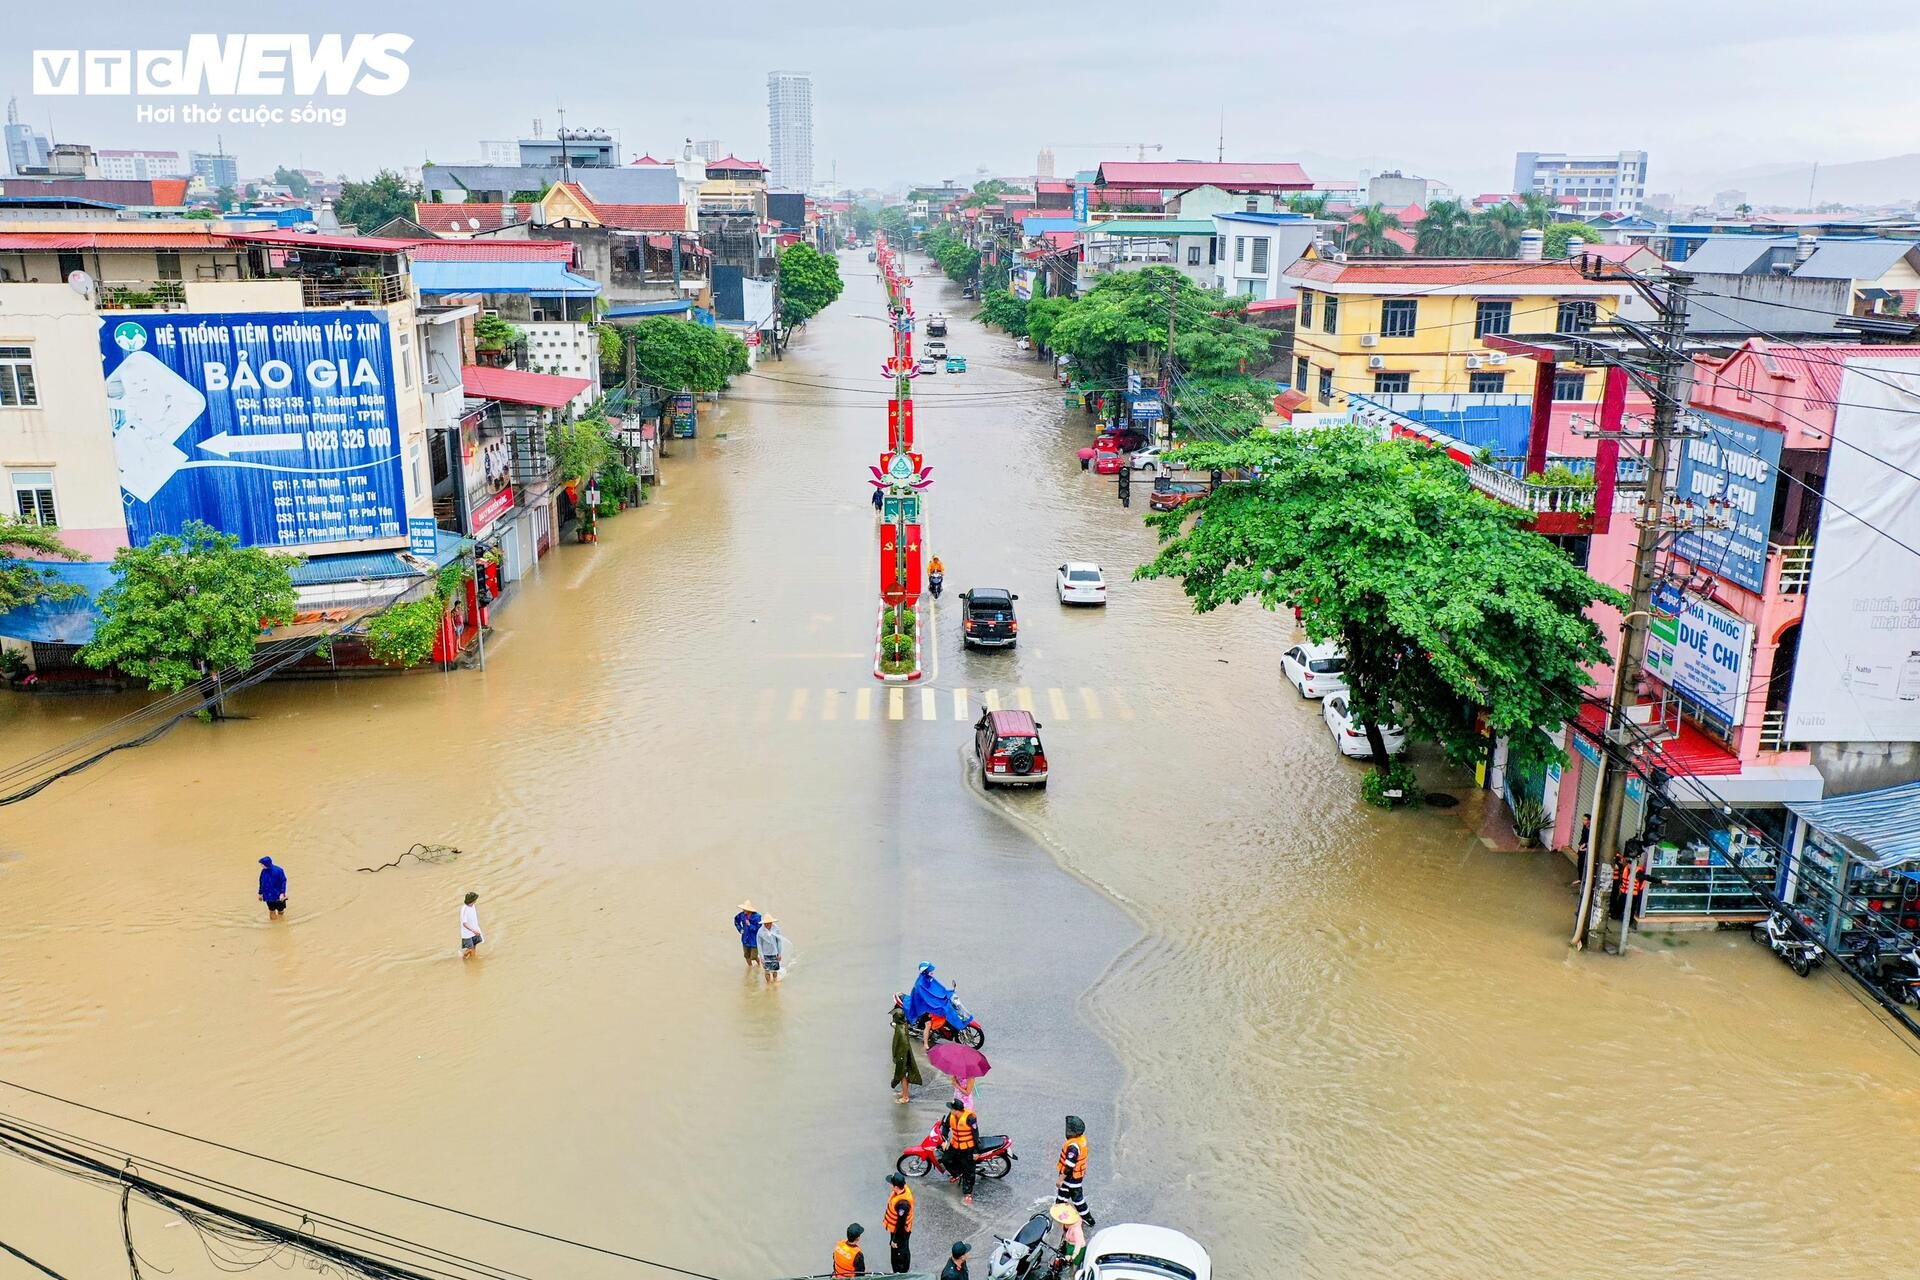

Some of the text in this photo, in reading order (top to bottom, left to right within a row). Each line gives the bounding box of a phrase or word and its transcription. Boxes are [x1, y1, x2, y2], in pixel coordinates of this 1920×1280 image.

[155, 318, 380, 348] HỆ THỐNG TIÊM CHỦNG VẮC XIN
[203, 350, 380, 391] BẢO GIA
[236, 398, 260, 409] CS4:
[262, 397, 304, 408] 133-135
[326, 395, 357, 408] Hoàng
[239, 415, 249, 426] P.
[252, 414, 281, 425] Phan
[284, 412, 309, 424] Đình
[312, 412, 347, 425] Phùng
[357, 410, 384, 421] TPTN
[307, 427, 392, 450] 0828 326 000
[1688, 439, 1769, 483] NHÀ THUỐC
[1726, 483, 1757, 515] CHI
[1707, 612, 1740, 640] THUỐC
[1680, 623, 1709, 658] DUỆ
[1712, 643, 1739, 673] CHI
[1855, 665, 1872, 674] Natto
[1796, 715, 1826, 727] Natto
